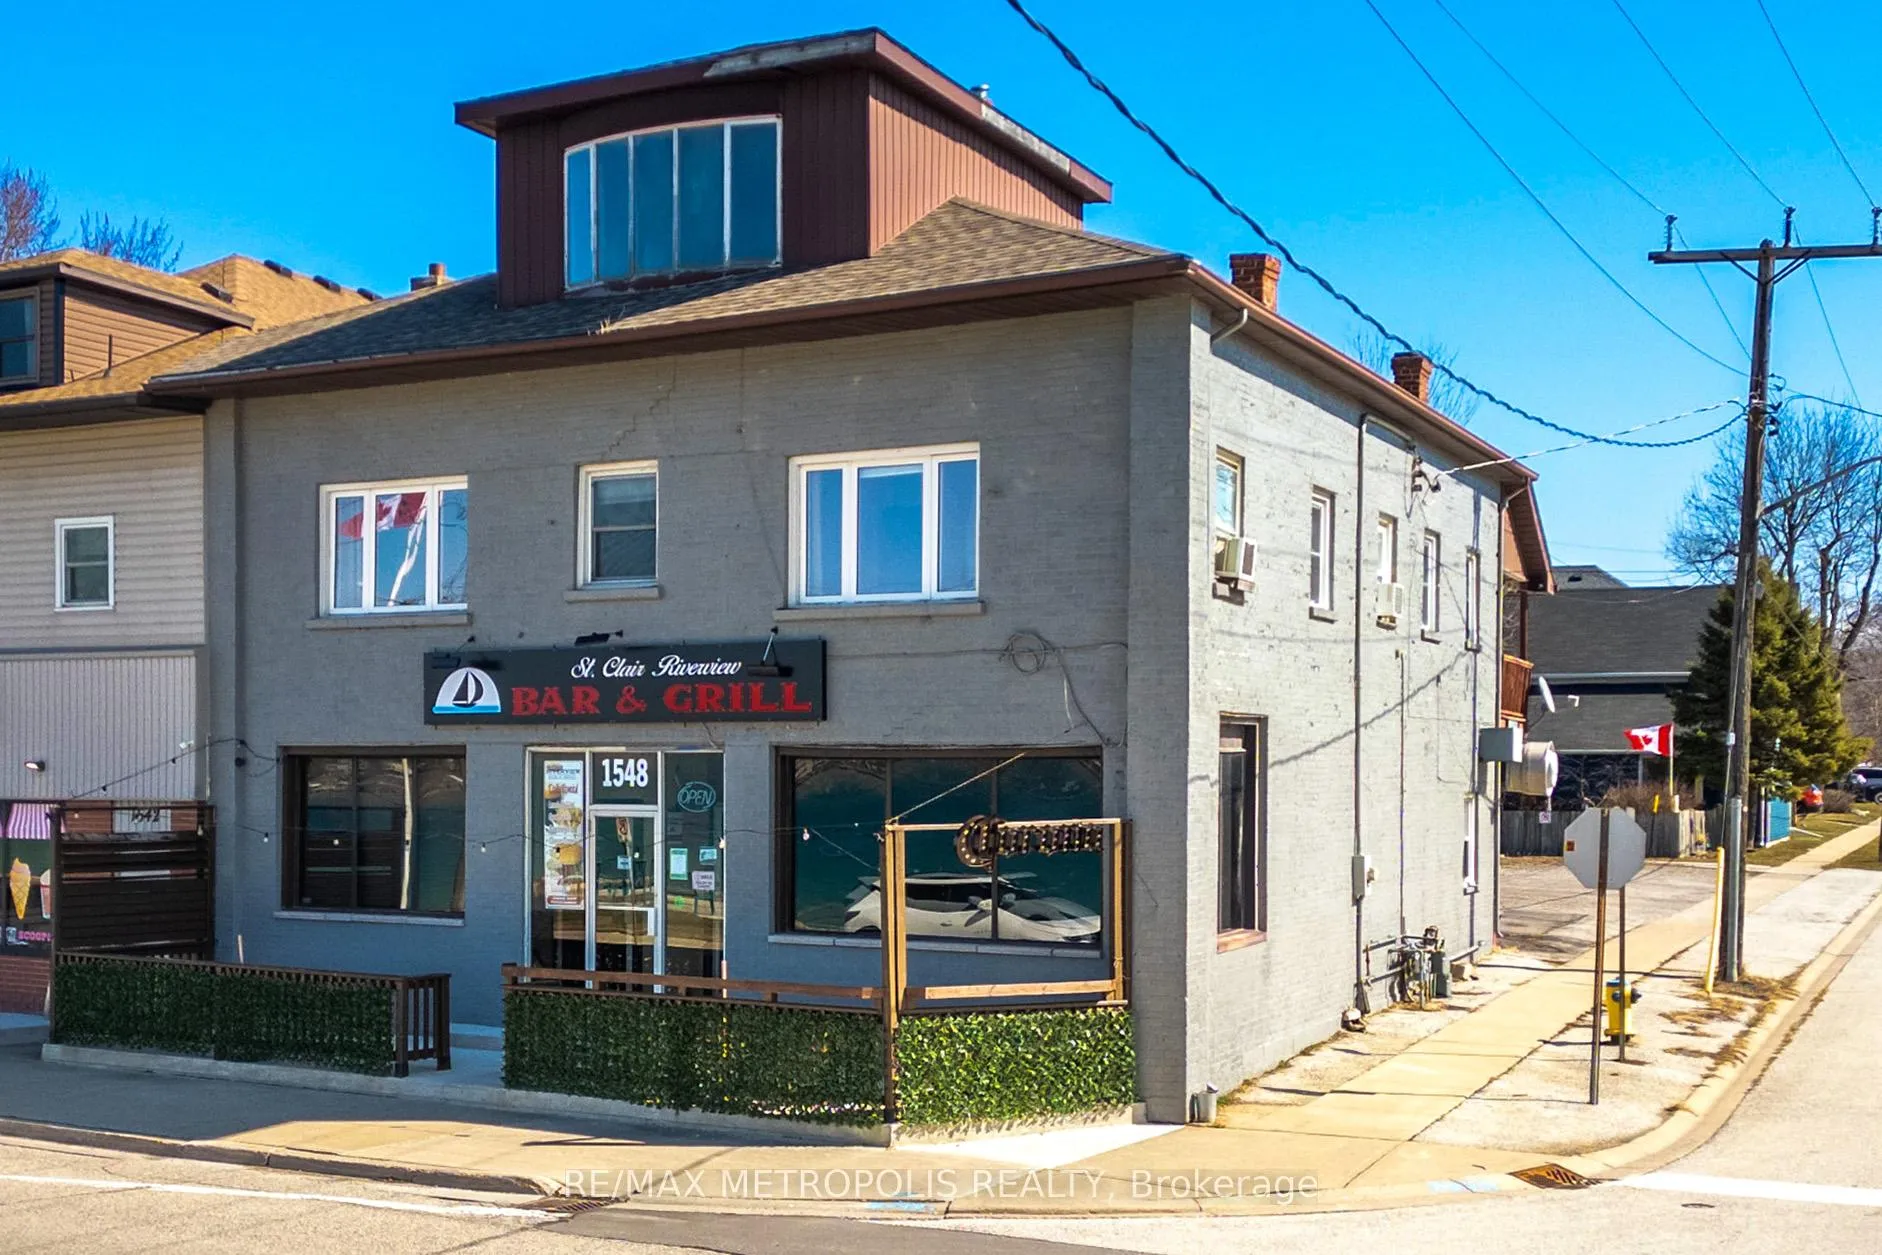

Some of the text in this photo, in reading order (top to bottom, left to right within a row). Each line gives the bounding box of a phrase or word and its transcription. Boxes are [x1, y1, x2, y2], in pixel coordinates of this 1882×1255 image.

[571, 654, 742, 678] St. Clair Riverview
[511, 681, 813, 716] BAR & GRILL
[602, 758, 648, 787] 1548
[680, 789, 713, 805] OPEN
